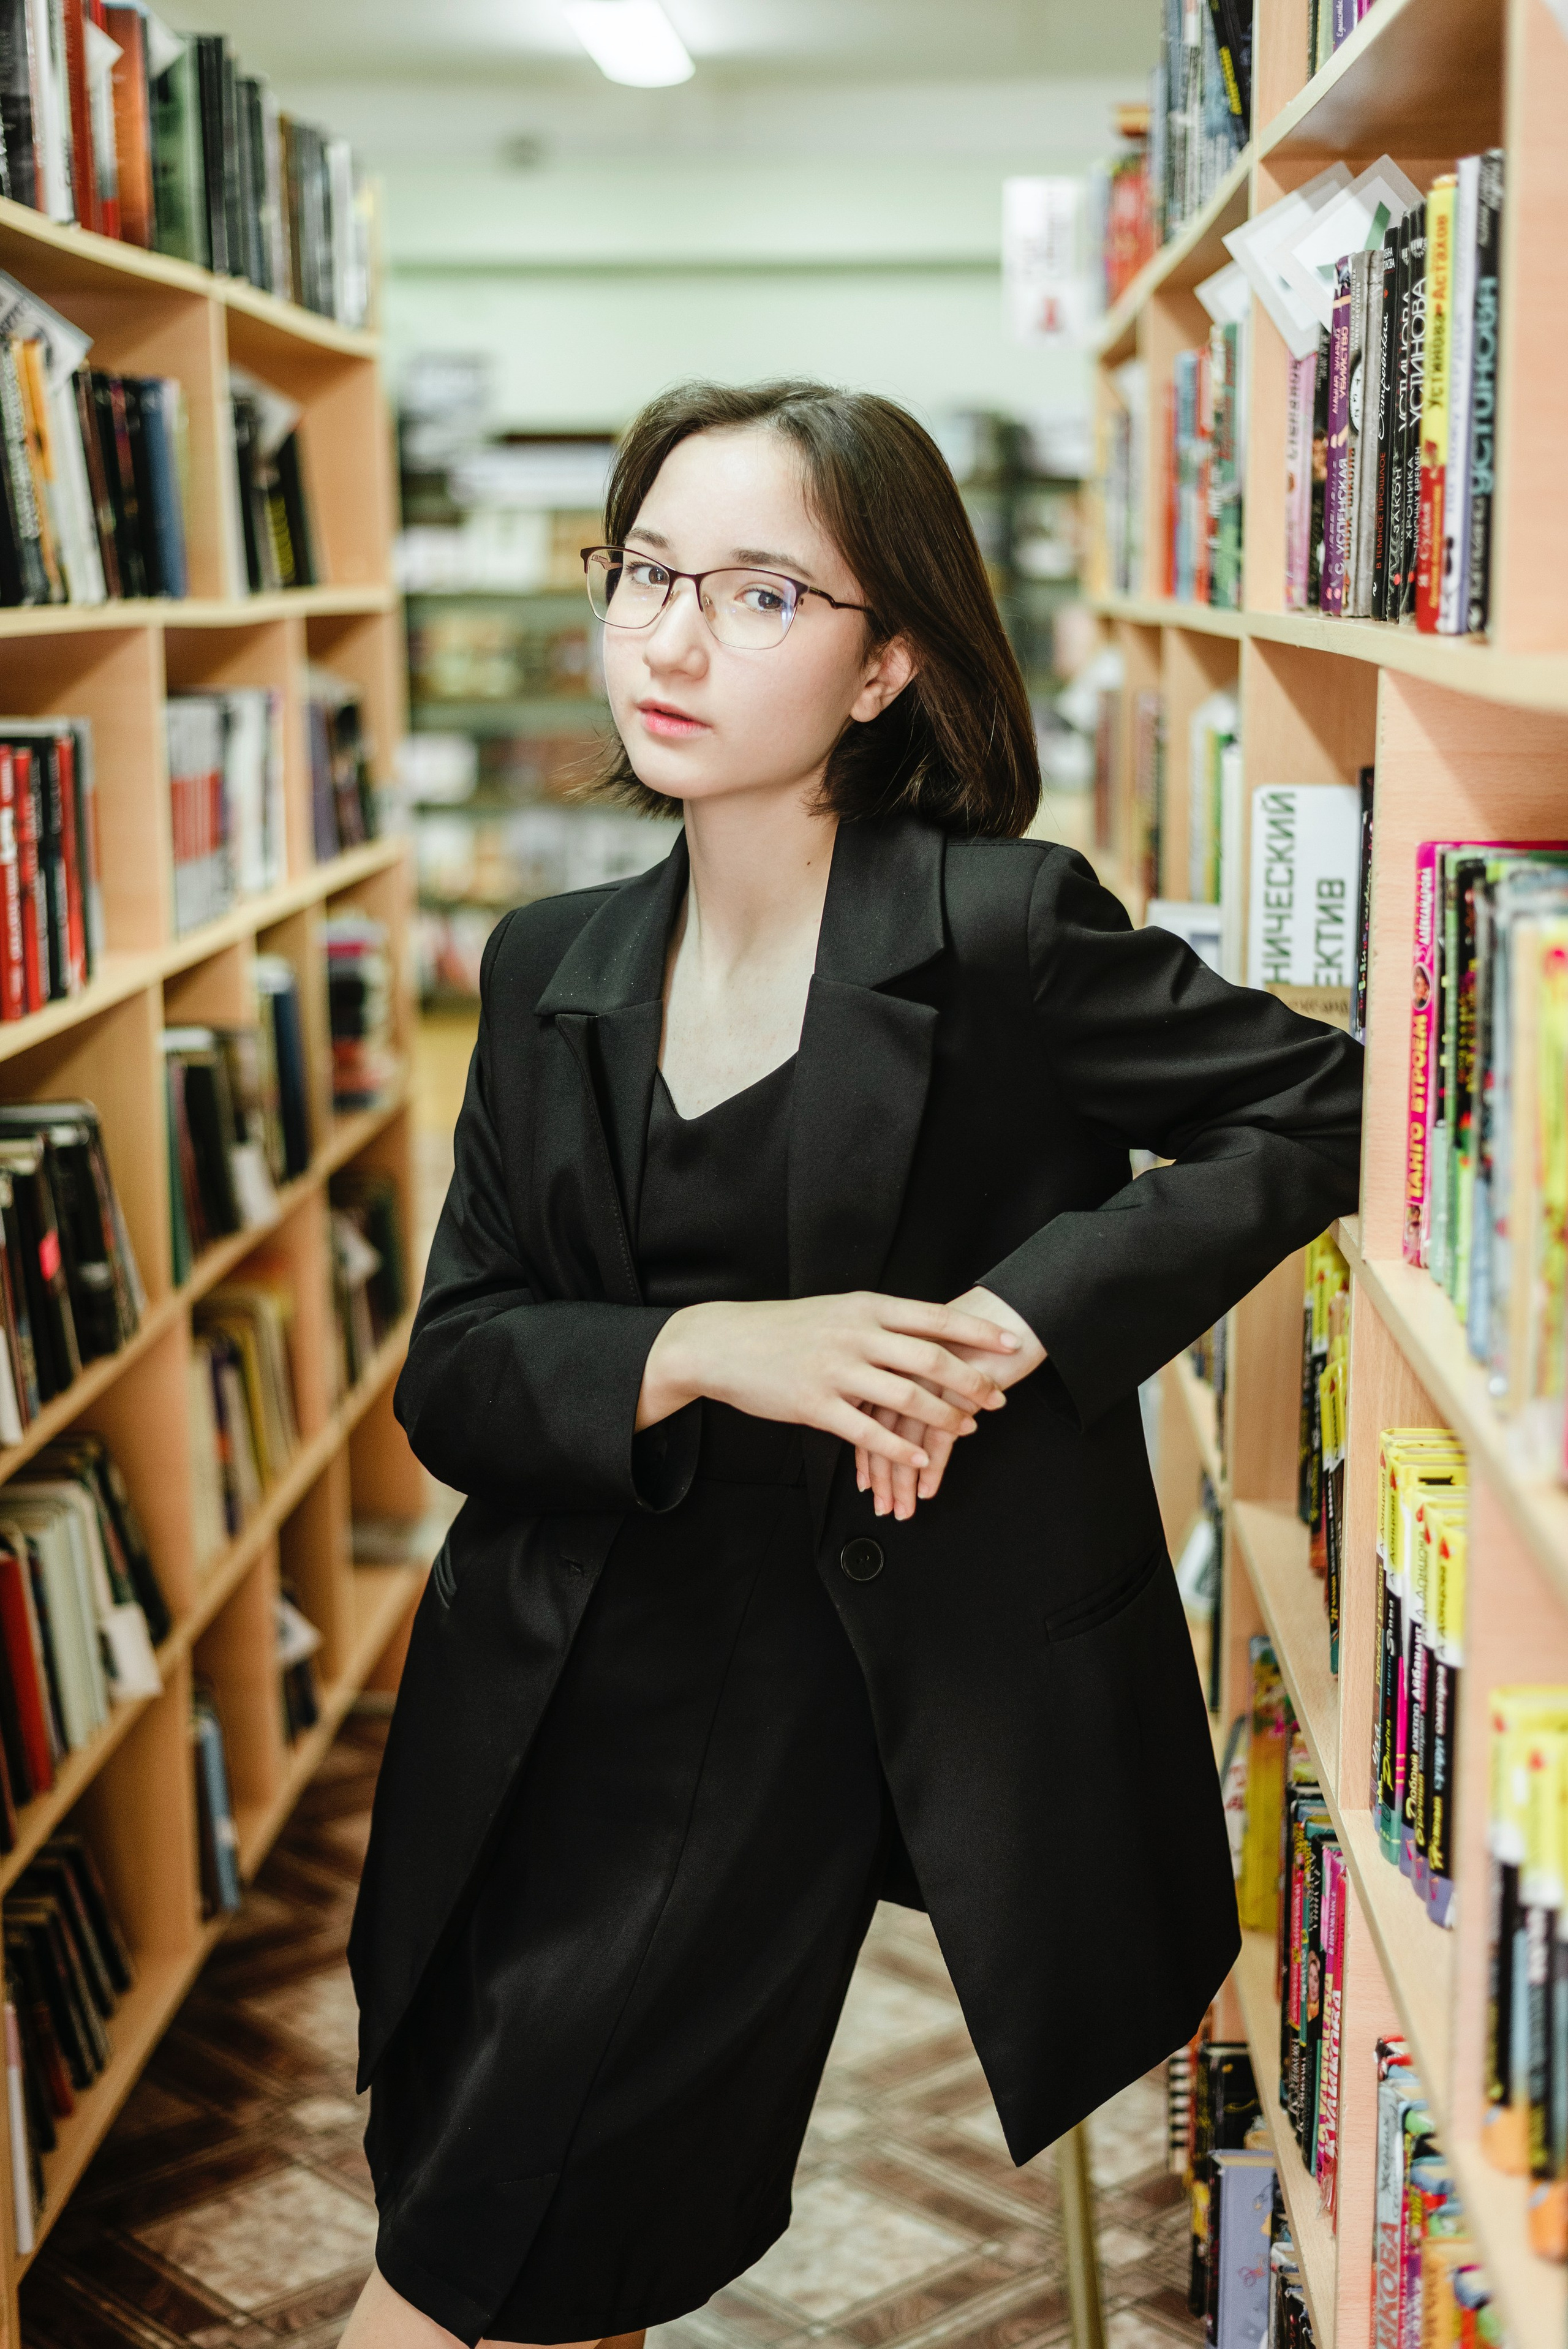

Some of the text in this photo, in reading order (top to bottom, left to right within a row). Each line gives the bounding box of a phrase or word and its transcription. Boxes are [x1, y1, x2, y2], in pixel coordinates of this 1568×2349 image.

[1409, 277, 1427, 428] УСТИНОВА
[1336, 458, 1348, 555] УСПЕНСКАЯ
[1405, 1014, 1428, 1199] ТАНГО ВТРОЕМ
